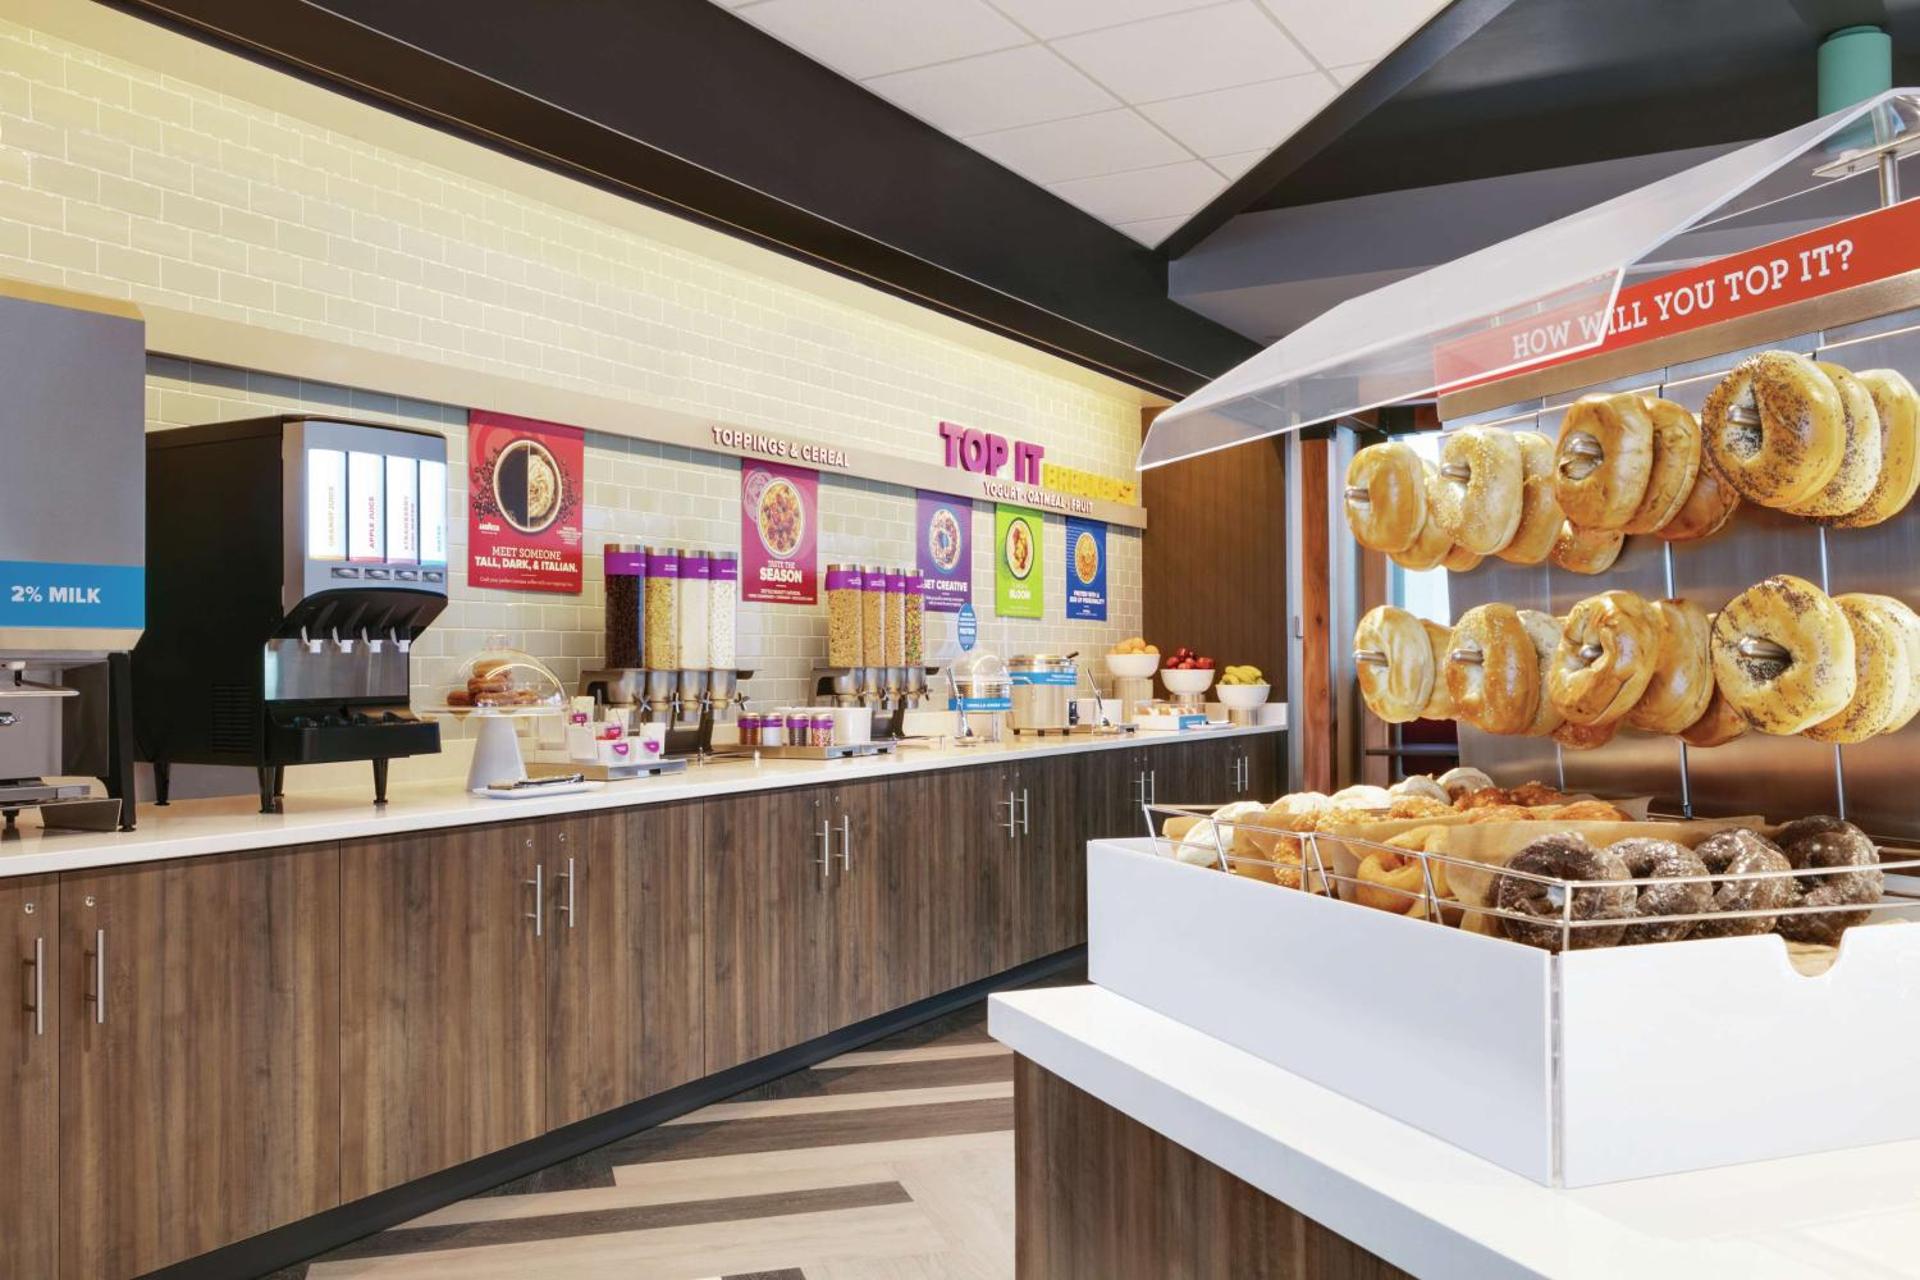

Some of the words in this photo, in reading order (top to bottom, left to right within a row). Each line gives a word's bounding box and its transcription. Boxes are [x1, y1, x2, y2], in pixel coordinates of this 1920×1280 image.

[1512, 320, 1571, 360] HOW
[1579, 301, 1648, 341] WILL
[1654, 280, 1715, 322] YOU
[1724, 259, 1789, 301] TOP
[1799, 239, 1854, 282] IT?
[712, 426, 787, 456] TOPPINGS
[790, 442, 799, 459] &
[802, 445, 850, 468] CEREAL
[939, 421, 1009, 477] TOP
[1014, 440, 1045, 486] IT
[983, 481, 1021, 501] YOGURT
[1027, 490, 1066, 509] OATMEAL
[1069, 498, 1093, 514] FRUIT
[491, 546, 517, 558] MEET
[519, 548, 562, 560] SOMEONE
[474, 556, 501, 569] TALL,
[502, 557, 532, 571] DARK,
[532, 560, 539, 570] &
[541, 561, 578, 573] ITALIAN.
[760, 566, 803, 583] SEASON
[11, 585, 43, 602] 2%
[48, 586, 101, 603] MILK
[936, 580, 968, 592] CREATIVE
